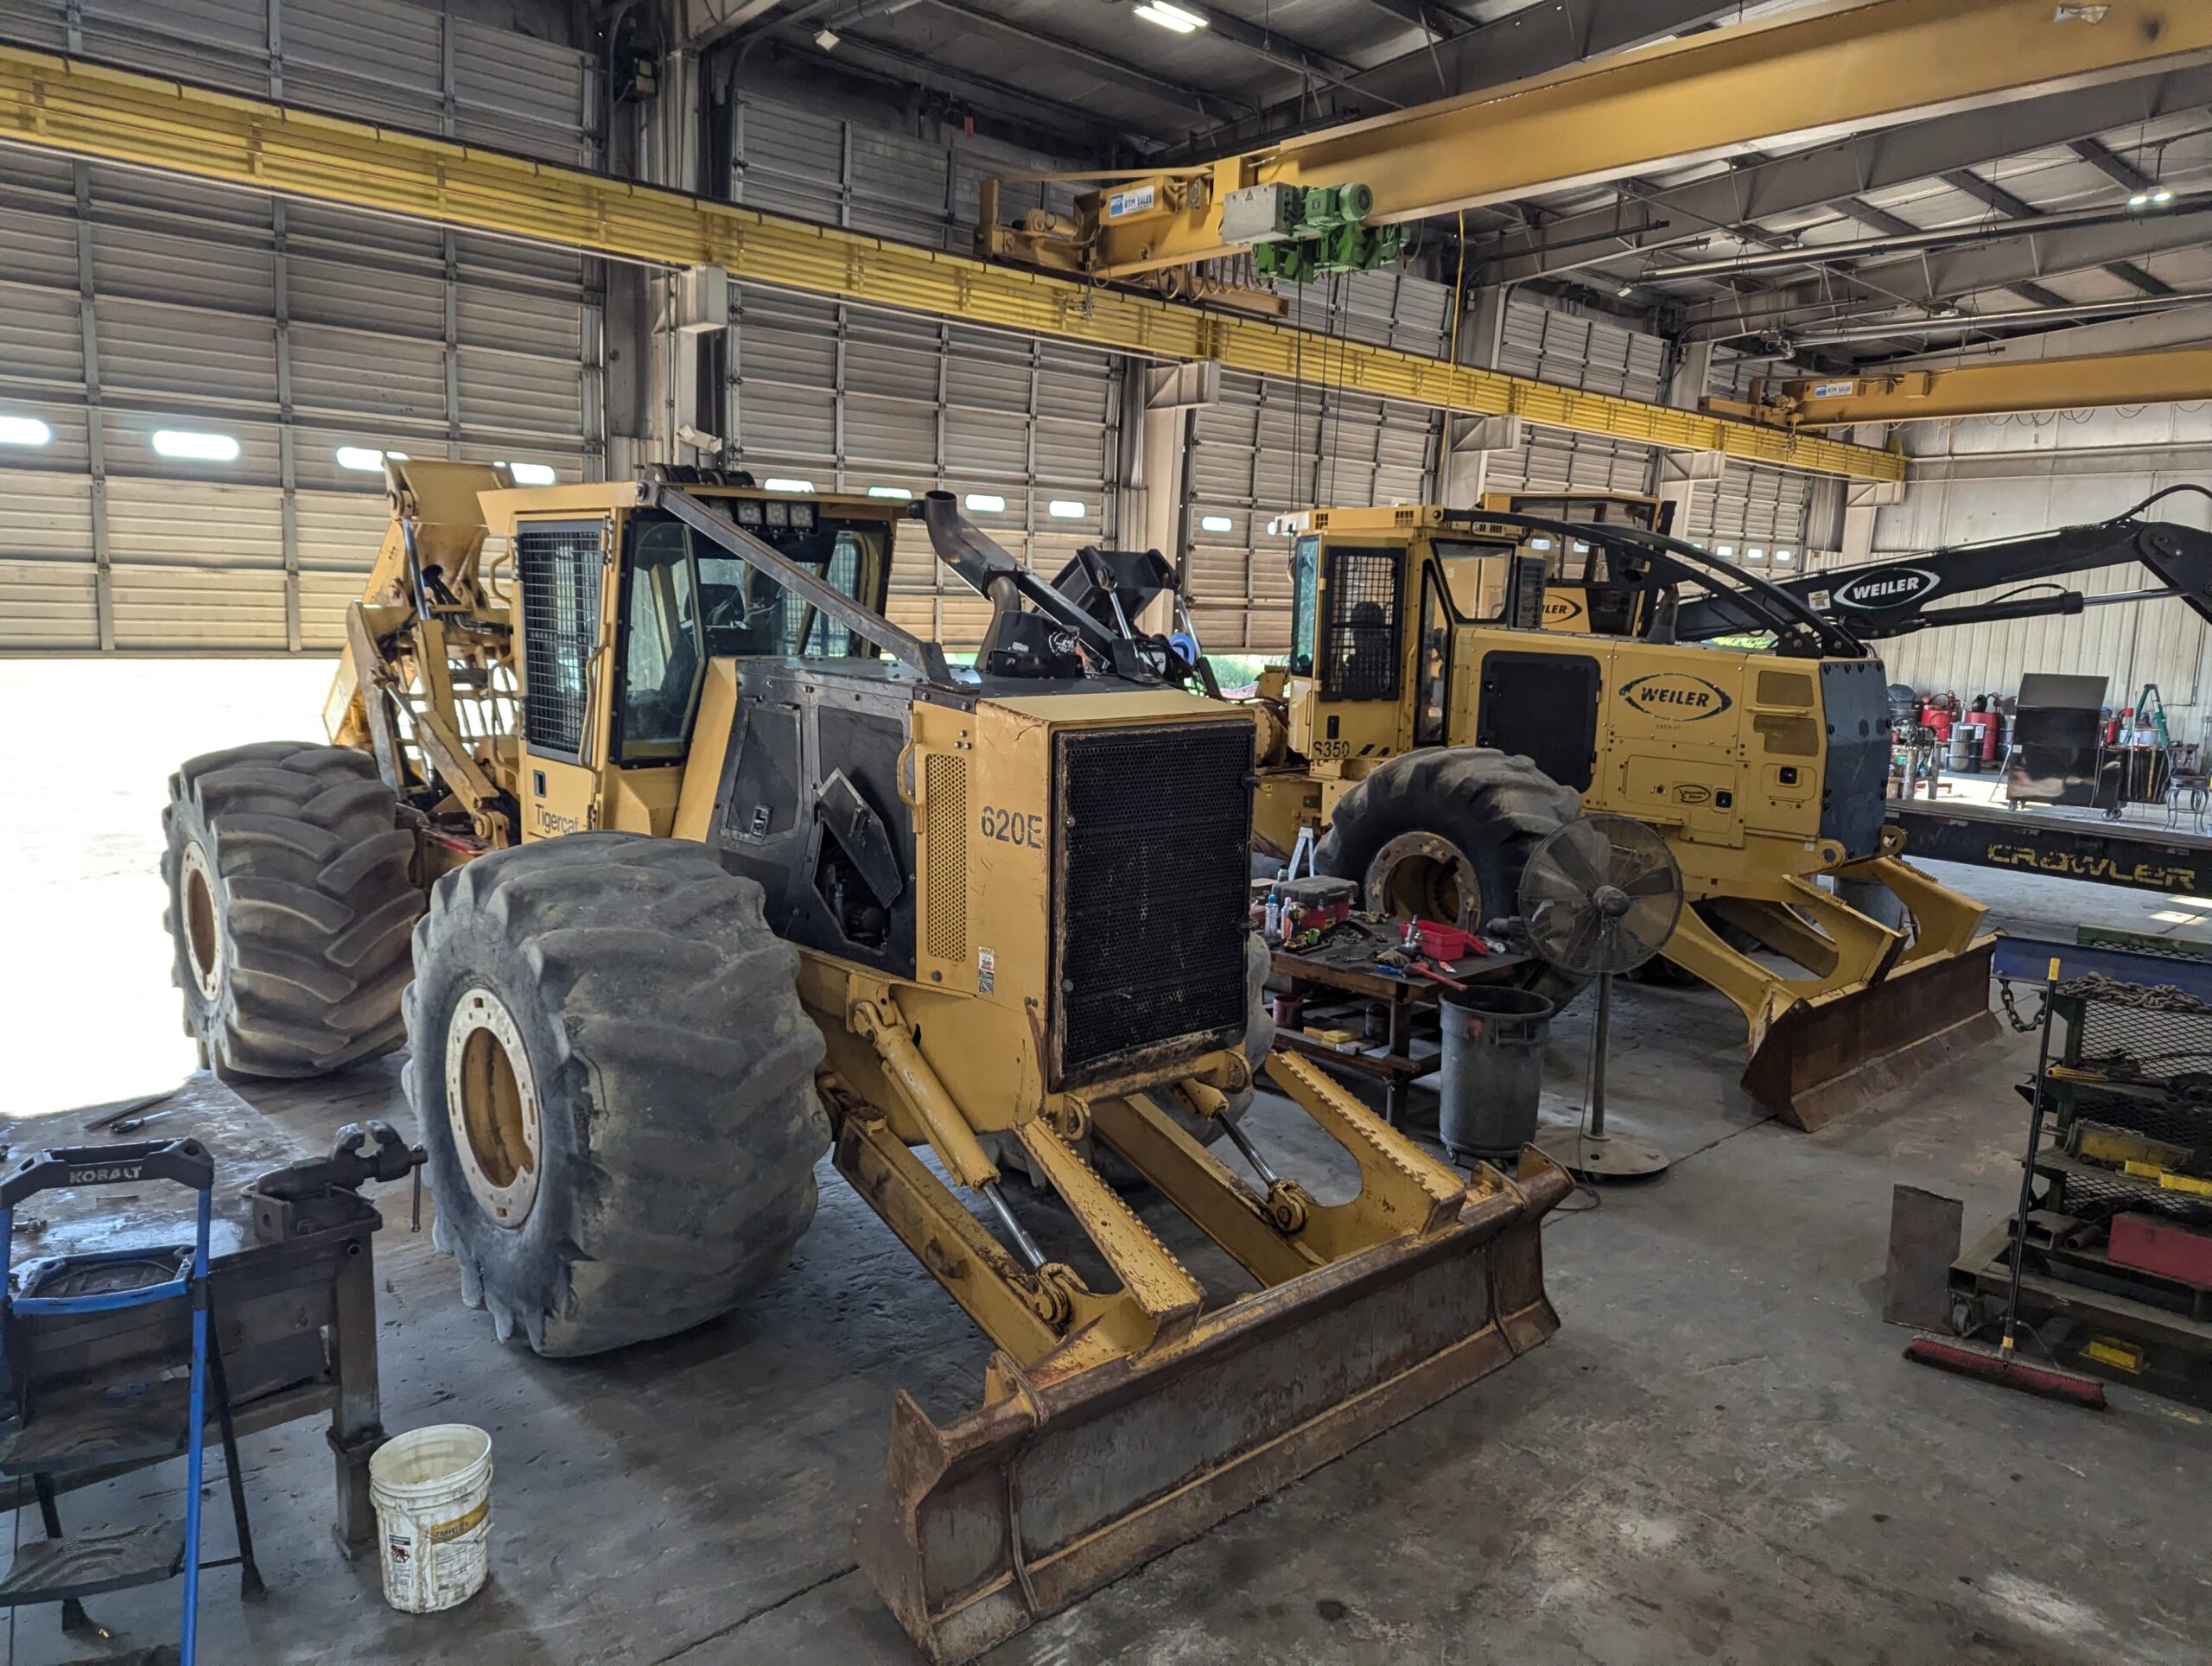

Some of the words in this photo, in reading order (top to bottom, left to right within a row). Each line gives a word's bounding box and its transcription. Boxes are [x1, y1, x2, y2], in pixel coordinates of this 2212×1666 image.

[1137, 194, 1152, 206] SALES
[1853, 576, 1920, 600] WEILER
[1641, 687, 1710, 707] WEILER
[1313, 741, 1351, 758] S350
[535, 803, 580, 834] Tigercat
[981, 804, 1043, 849] 620E
[69, 1166, 143, 1184] KOBALT
